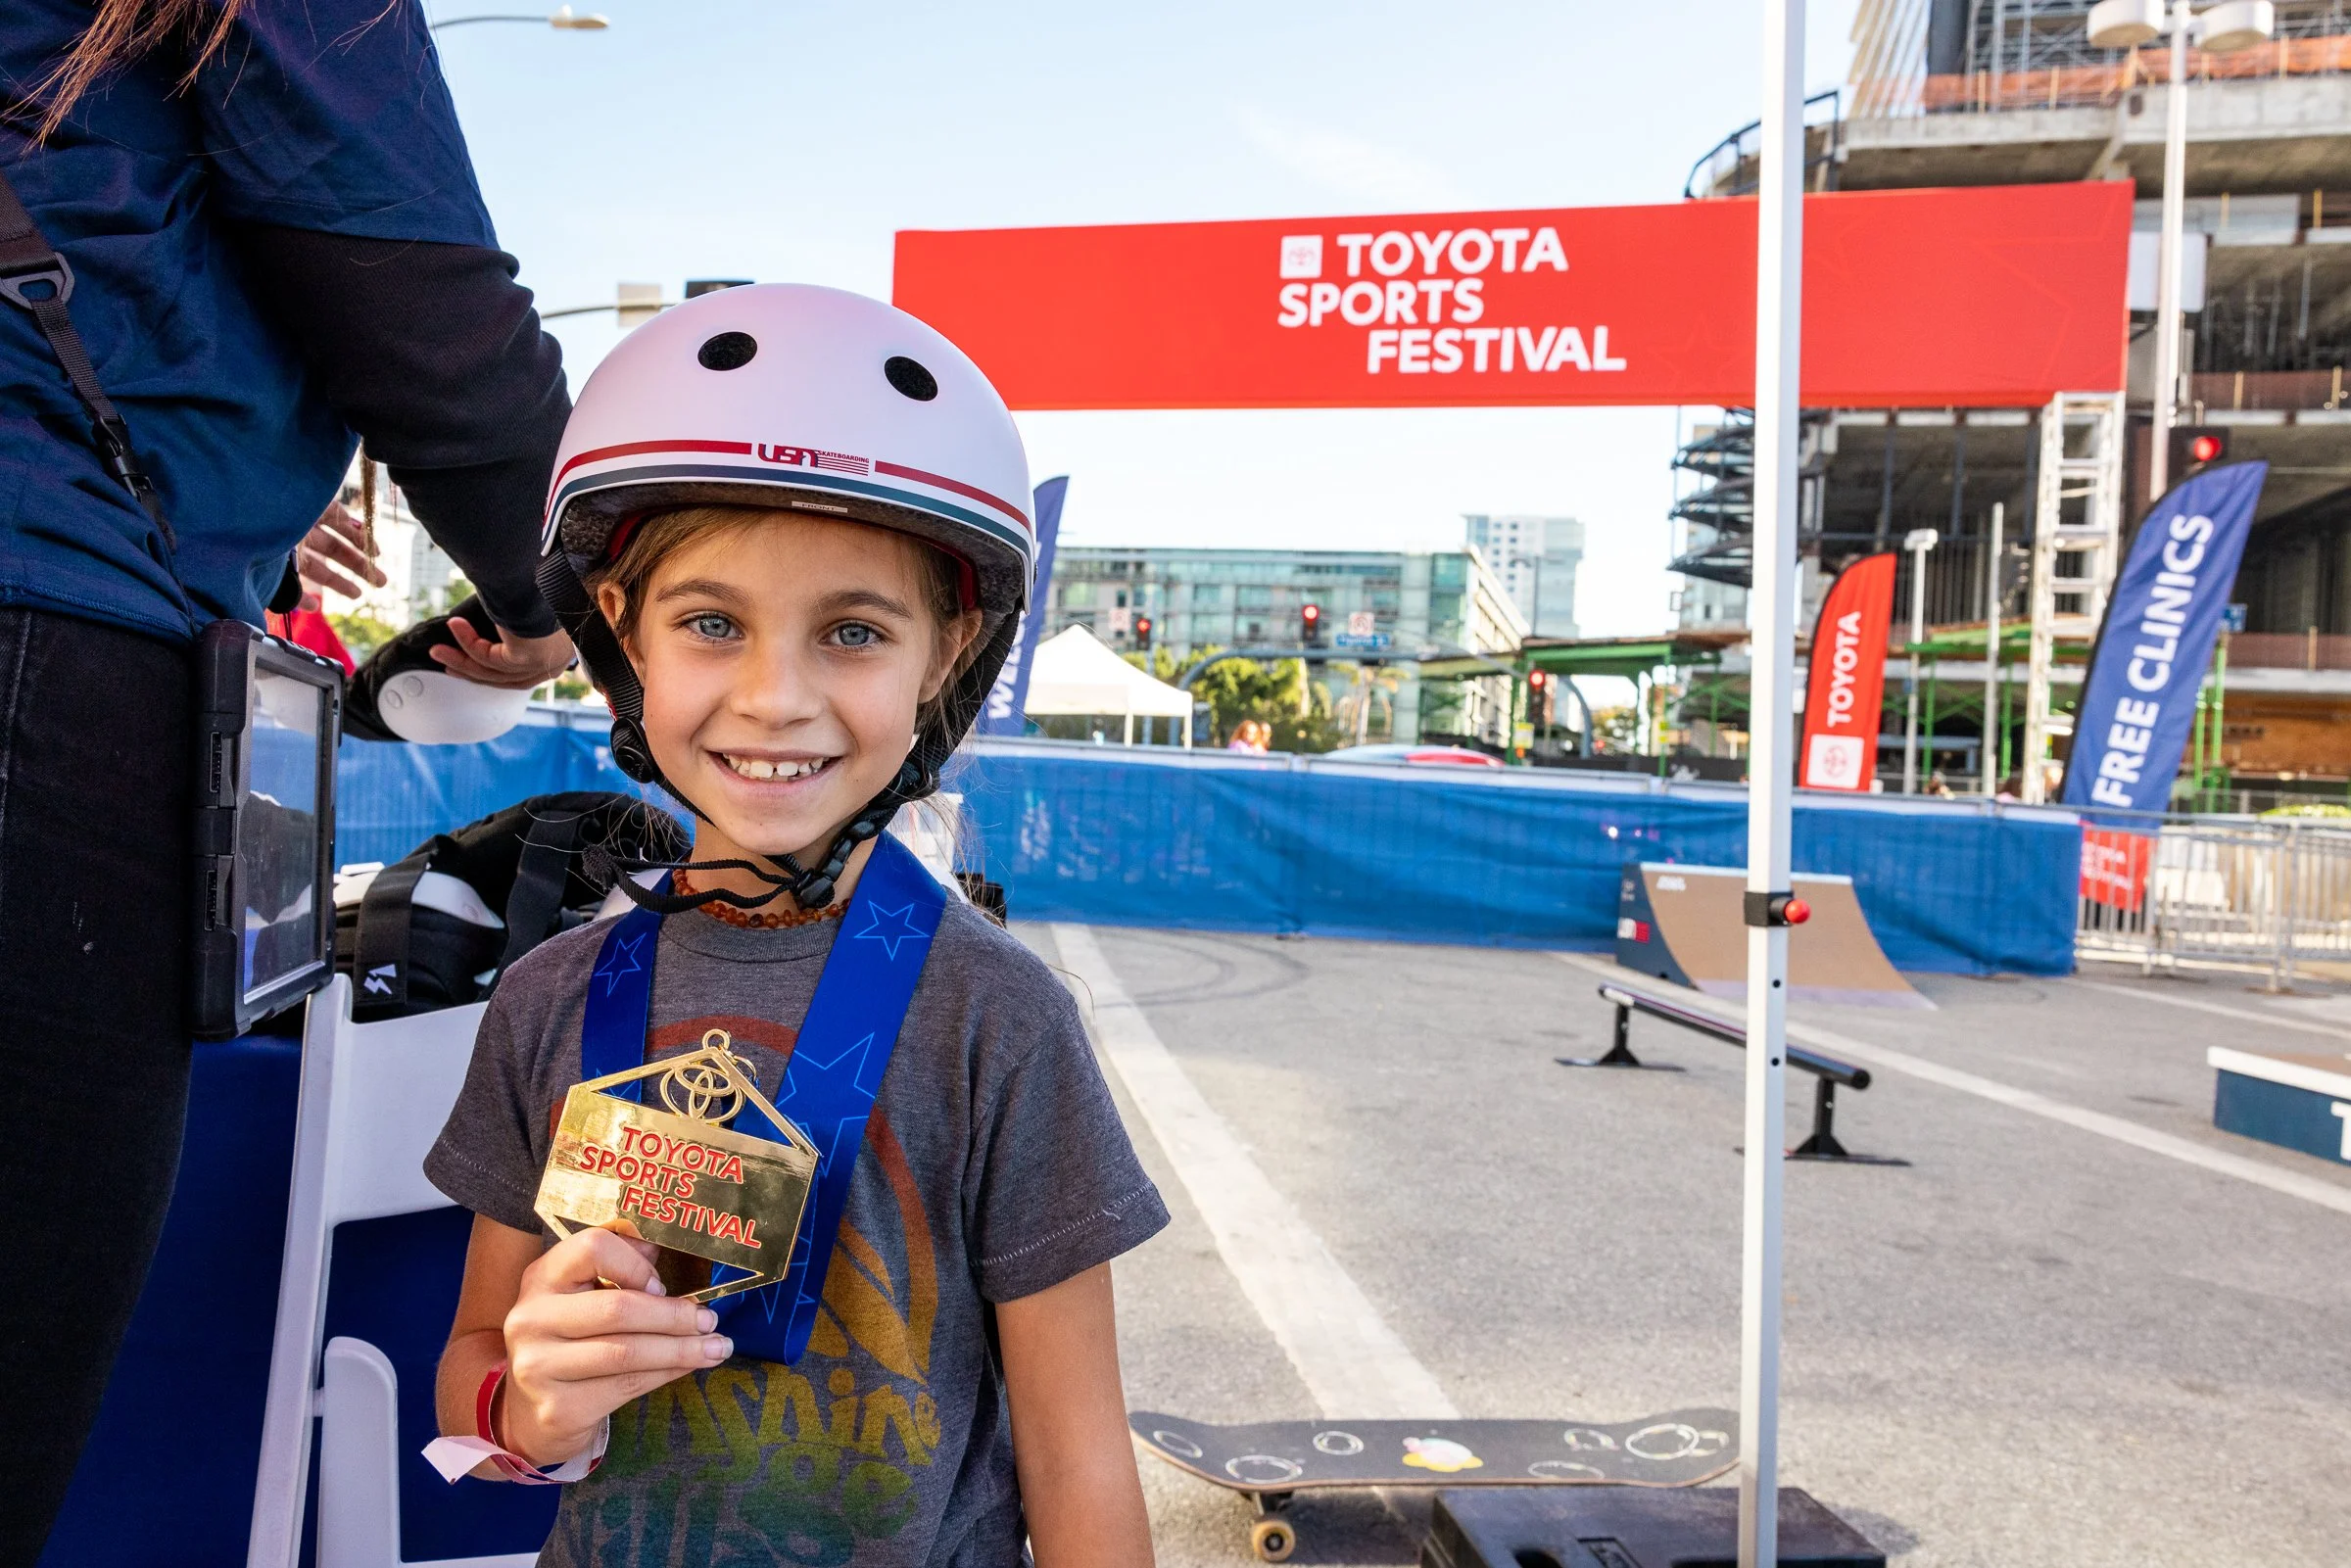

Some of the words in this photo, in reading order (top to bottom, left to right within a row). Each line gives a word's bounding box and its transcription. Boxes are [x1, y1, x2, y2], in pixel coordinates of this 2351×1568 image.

[1337, 227, 1569, 276] TOYOTA
[1277, 278, 1485, 327] SPORTS
[1367, 325, 1627, 374] FESTIVAL
[818, 451, 870, 464] SKATEBOARDING
[1827, 610, 1862, 729] TOYOTA
[2091, 696, 2160, 808] FREE
[2127, 514, 2215, 693] CLINICS
[579, 1145, 696, 1198] SPORTS
[622, 1126, 744, 1184] TOYOTA
[621, 1187, 762, 1250] FESTIVAL
